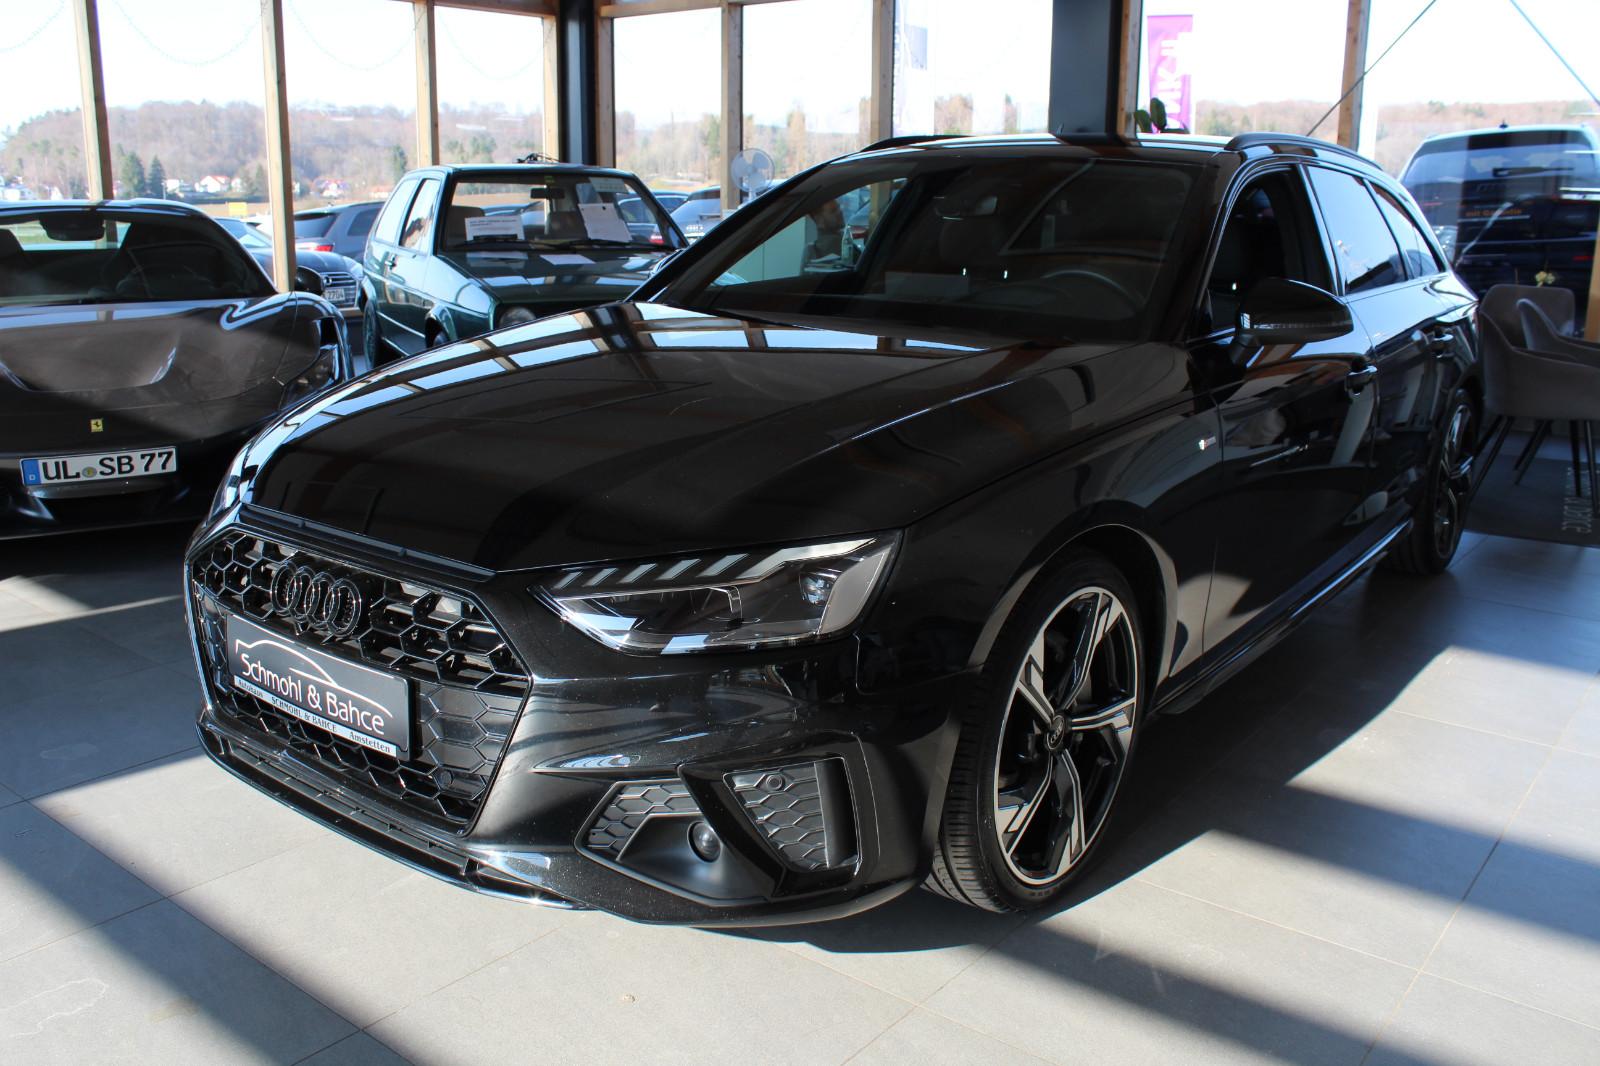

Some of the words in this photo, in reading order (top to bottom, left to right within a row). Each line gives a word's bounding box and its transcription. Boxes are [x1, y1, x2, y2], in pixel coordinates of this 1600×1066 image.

[42, 460, 80, 481] UL
[98, 455, 135, 476] SB
[140, 450, 174, 472] 77
[240, 652, 303, 703] Schmohl
[307, 684, 323, 712] &
[326, 691, 385, 736] Bahce
[312, 715, 338, 733] BAHCE
[350, 731, 392, 754] Amstetten
